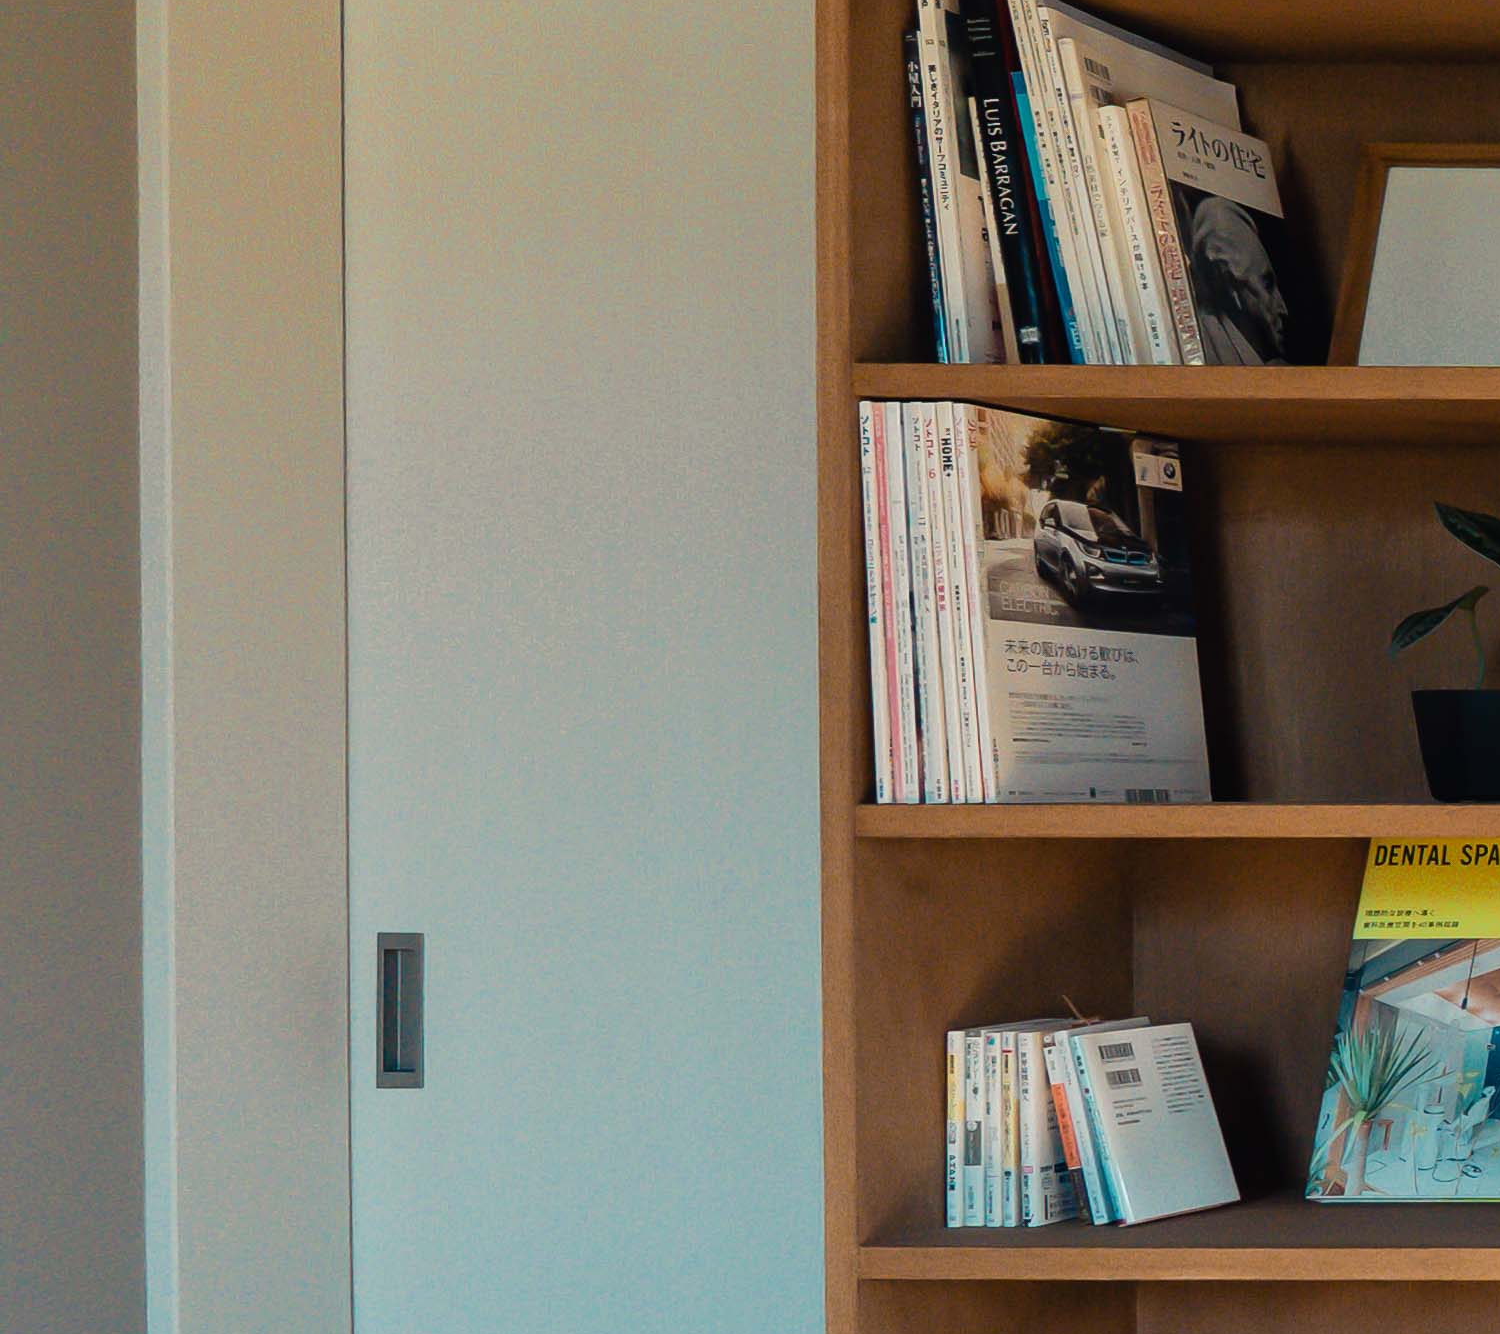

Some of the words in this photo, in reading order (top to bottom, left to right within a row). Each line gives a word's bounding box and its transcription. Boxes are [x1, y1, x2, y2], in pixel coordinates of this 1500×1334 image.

[983, 98, 1003, 136] LUIS
[1171, 121, 1267, 180] ライトの住宅
[990, 141, 1019, 236] BARRAGAN
[1374, 844, 1451, 867] DENTAL
